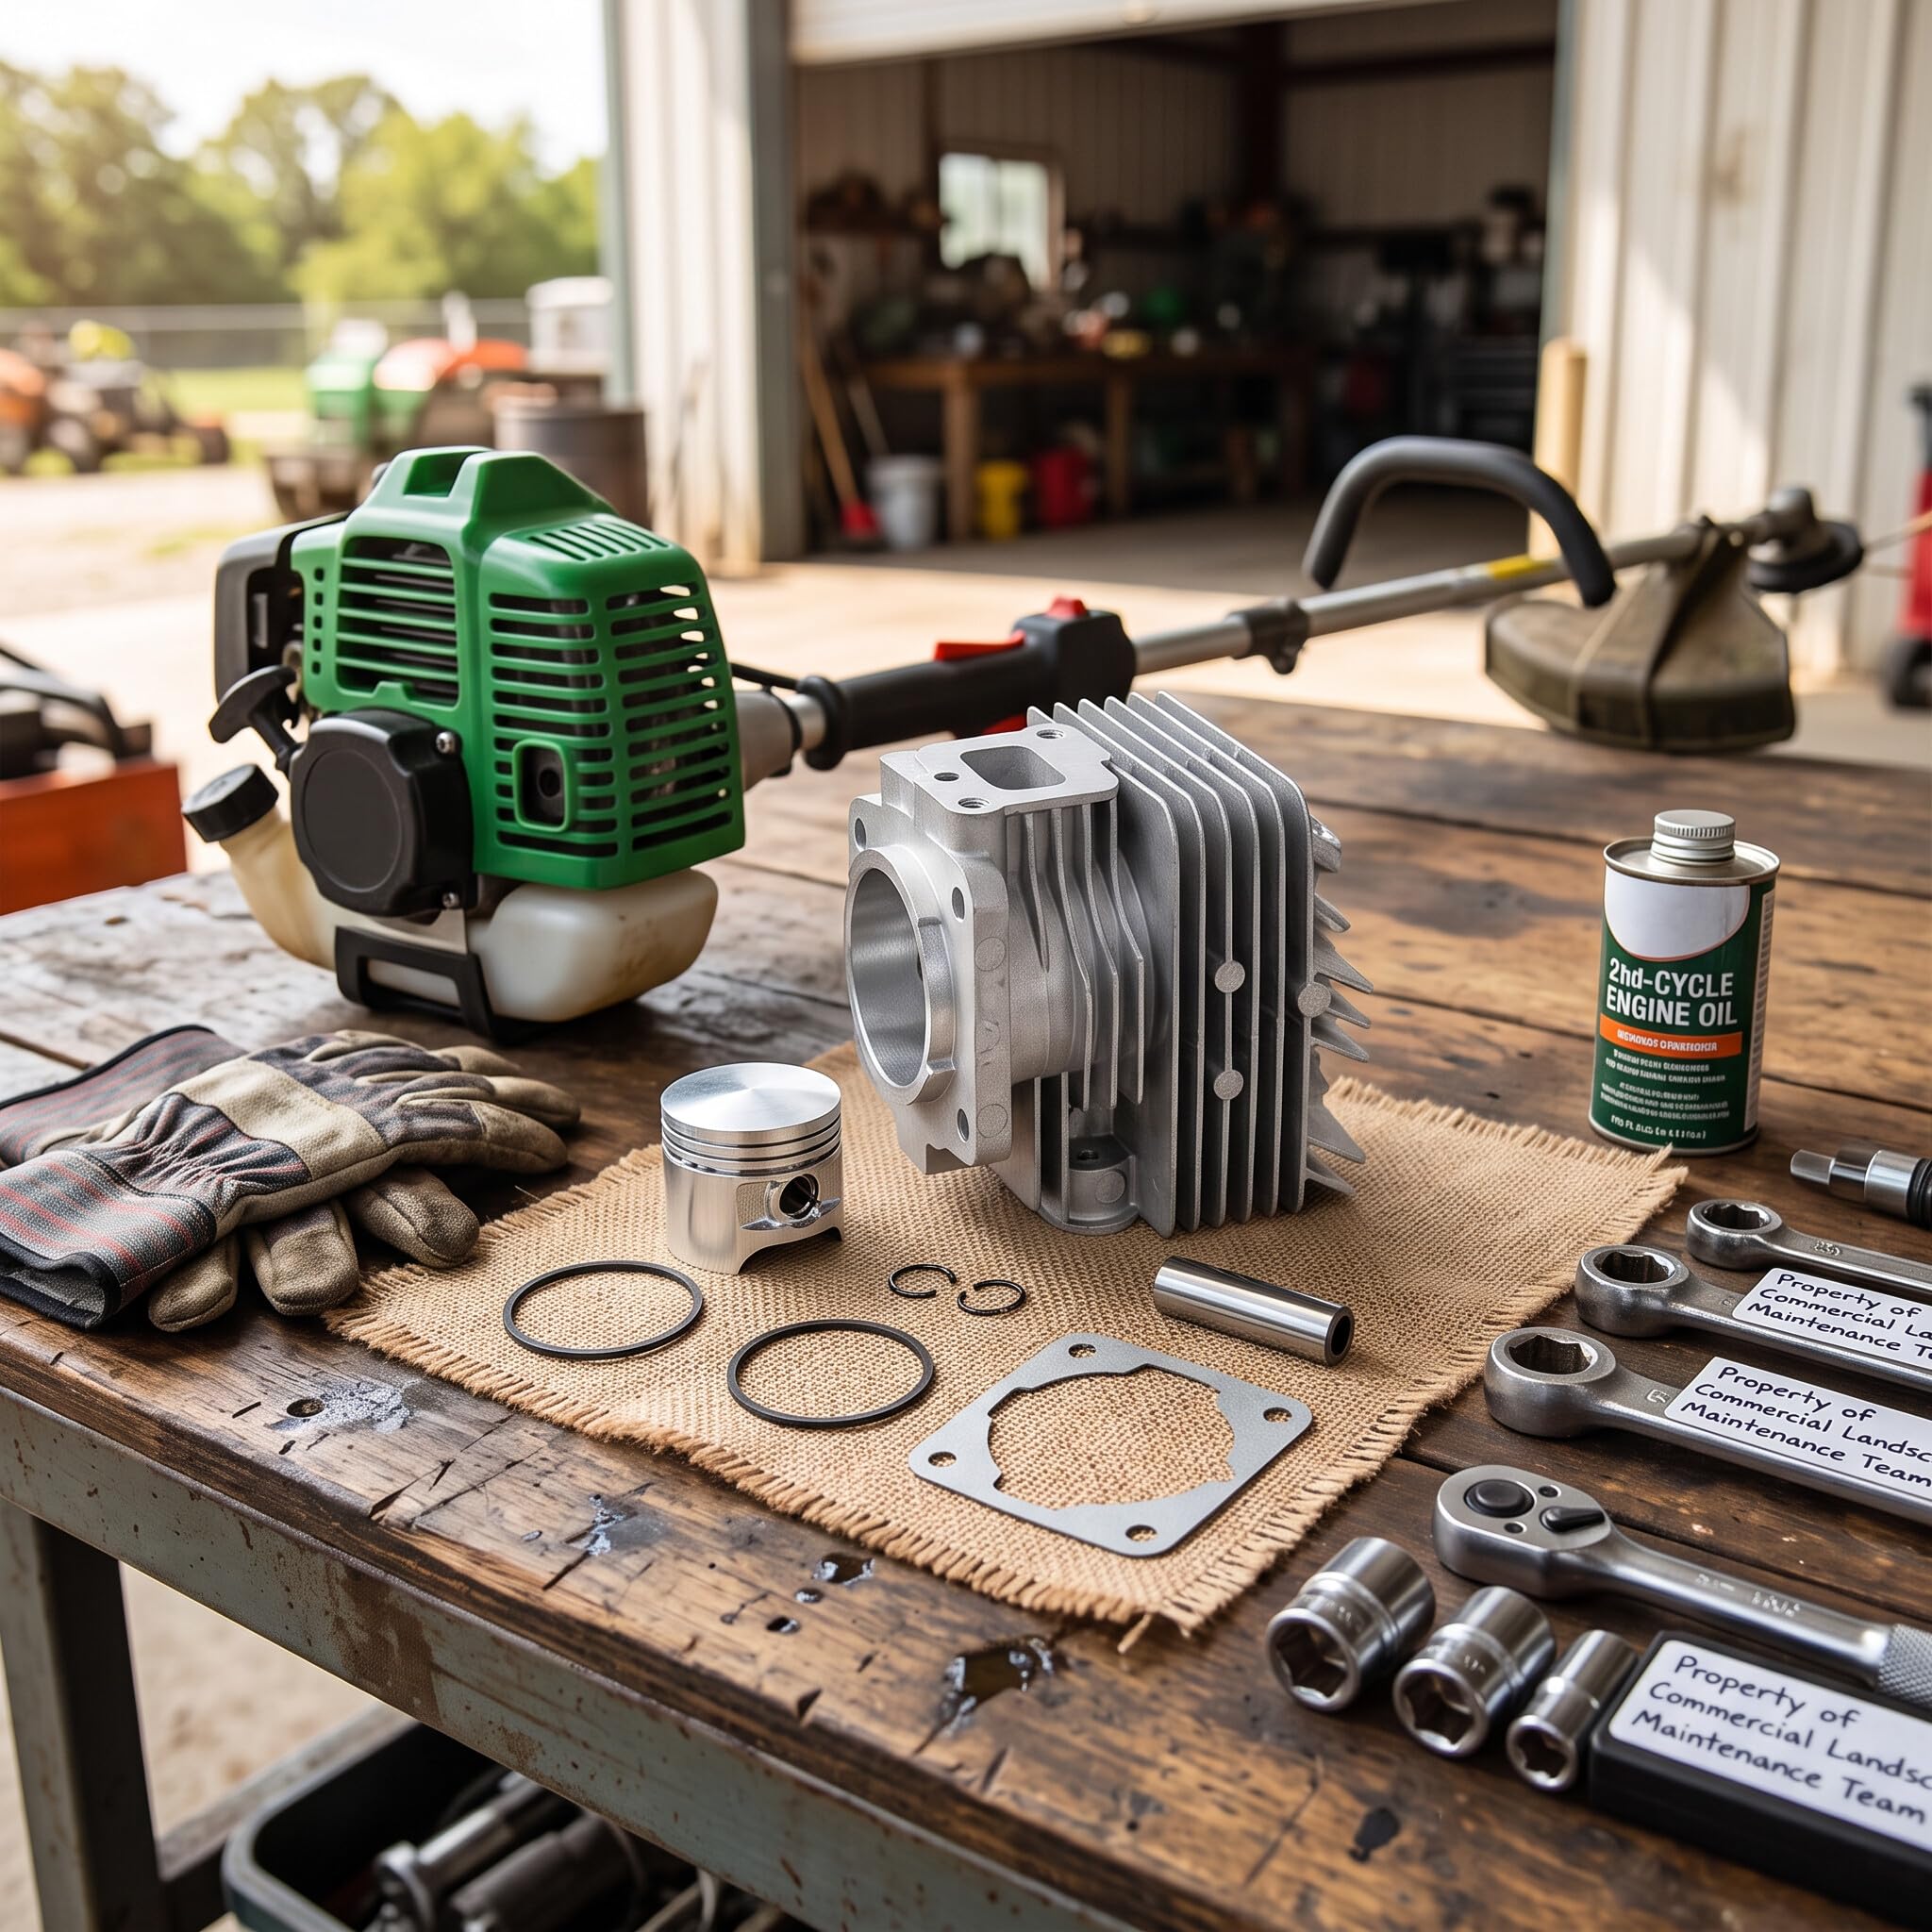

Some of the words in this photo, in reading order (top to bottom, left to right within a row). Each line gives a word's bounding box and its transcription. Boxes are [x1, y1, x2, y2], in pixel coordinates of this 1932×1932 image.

[1606, 984, 1690, 1026] ENGINE
[1698, 1001, 1738, 1027] OIL
[1759, 1289, 1896, 1330] Commercial
[1776, 1274, 1881, 1310] Property
[1890, 1307, 1923, 1318] of
[1747, 1303, 1902, 1351] Maintenance
[1694, 1384, 1832, 1432] Commercial
[1718, 1367, 1831, 1413] Property
[1841, 1408, 1877, 1422] of
[1680, 1402, 1846, 1461] Maintenance
[1862, 1453, 1932, 1488] Team
[1649, 1682, 1814, 1748] Commercial
[1674, 1655, 1806, 1717] Property
[1820, 1708, 1860, 1728] of
[1631, 1709, 1822, 1789] Maintenance
[1840, 1777, 1925, 1824] Team
